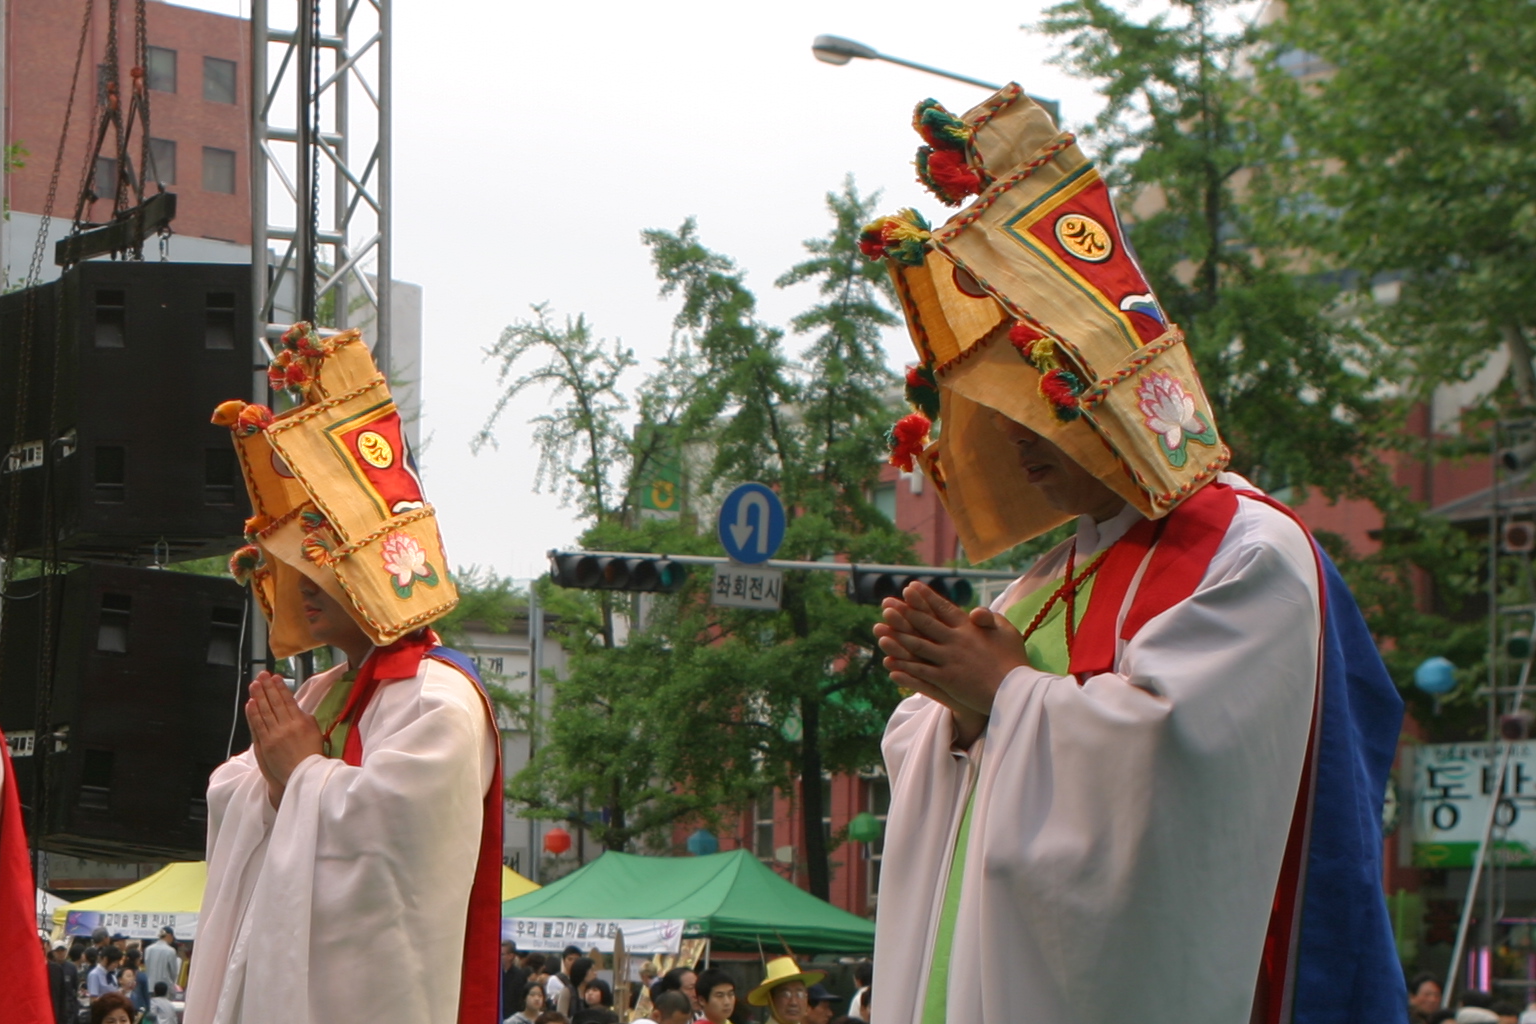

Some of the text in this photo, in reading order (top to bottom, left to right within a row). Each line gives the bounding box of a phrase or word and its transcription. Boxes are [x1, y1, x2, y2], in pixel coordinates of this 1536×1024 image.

[716, 573, 781, 602] 좌회전시
[516, 921, 538, 938] 우리
[542, 922, 590, 938] 불교미술
